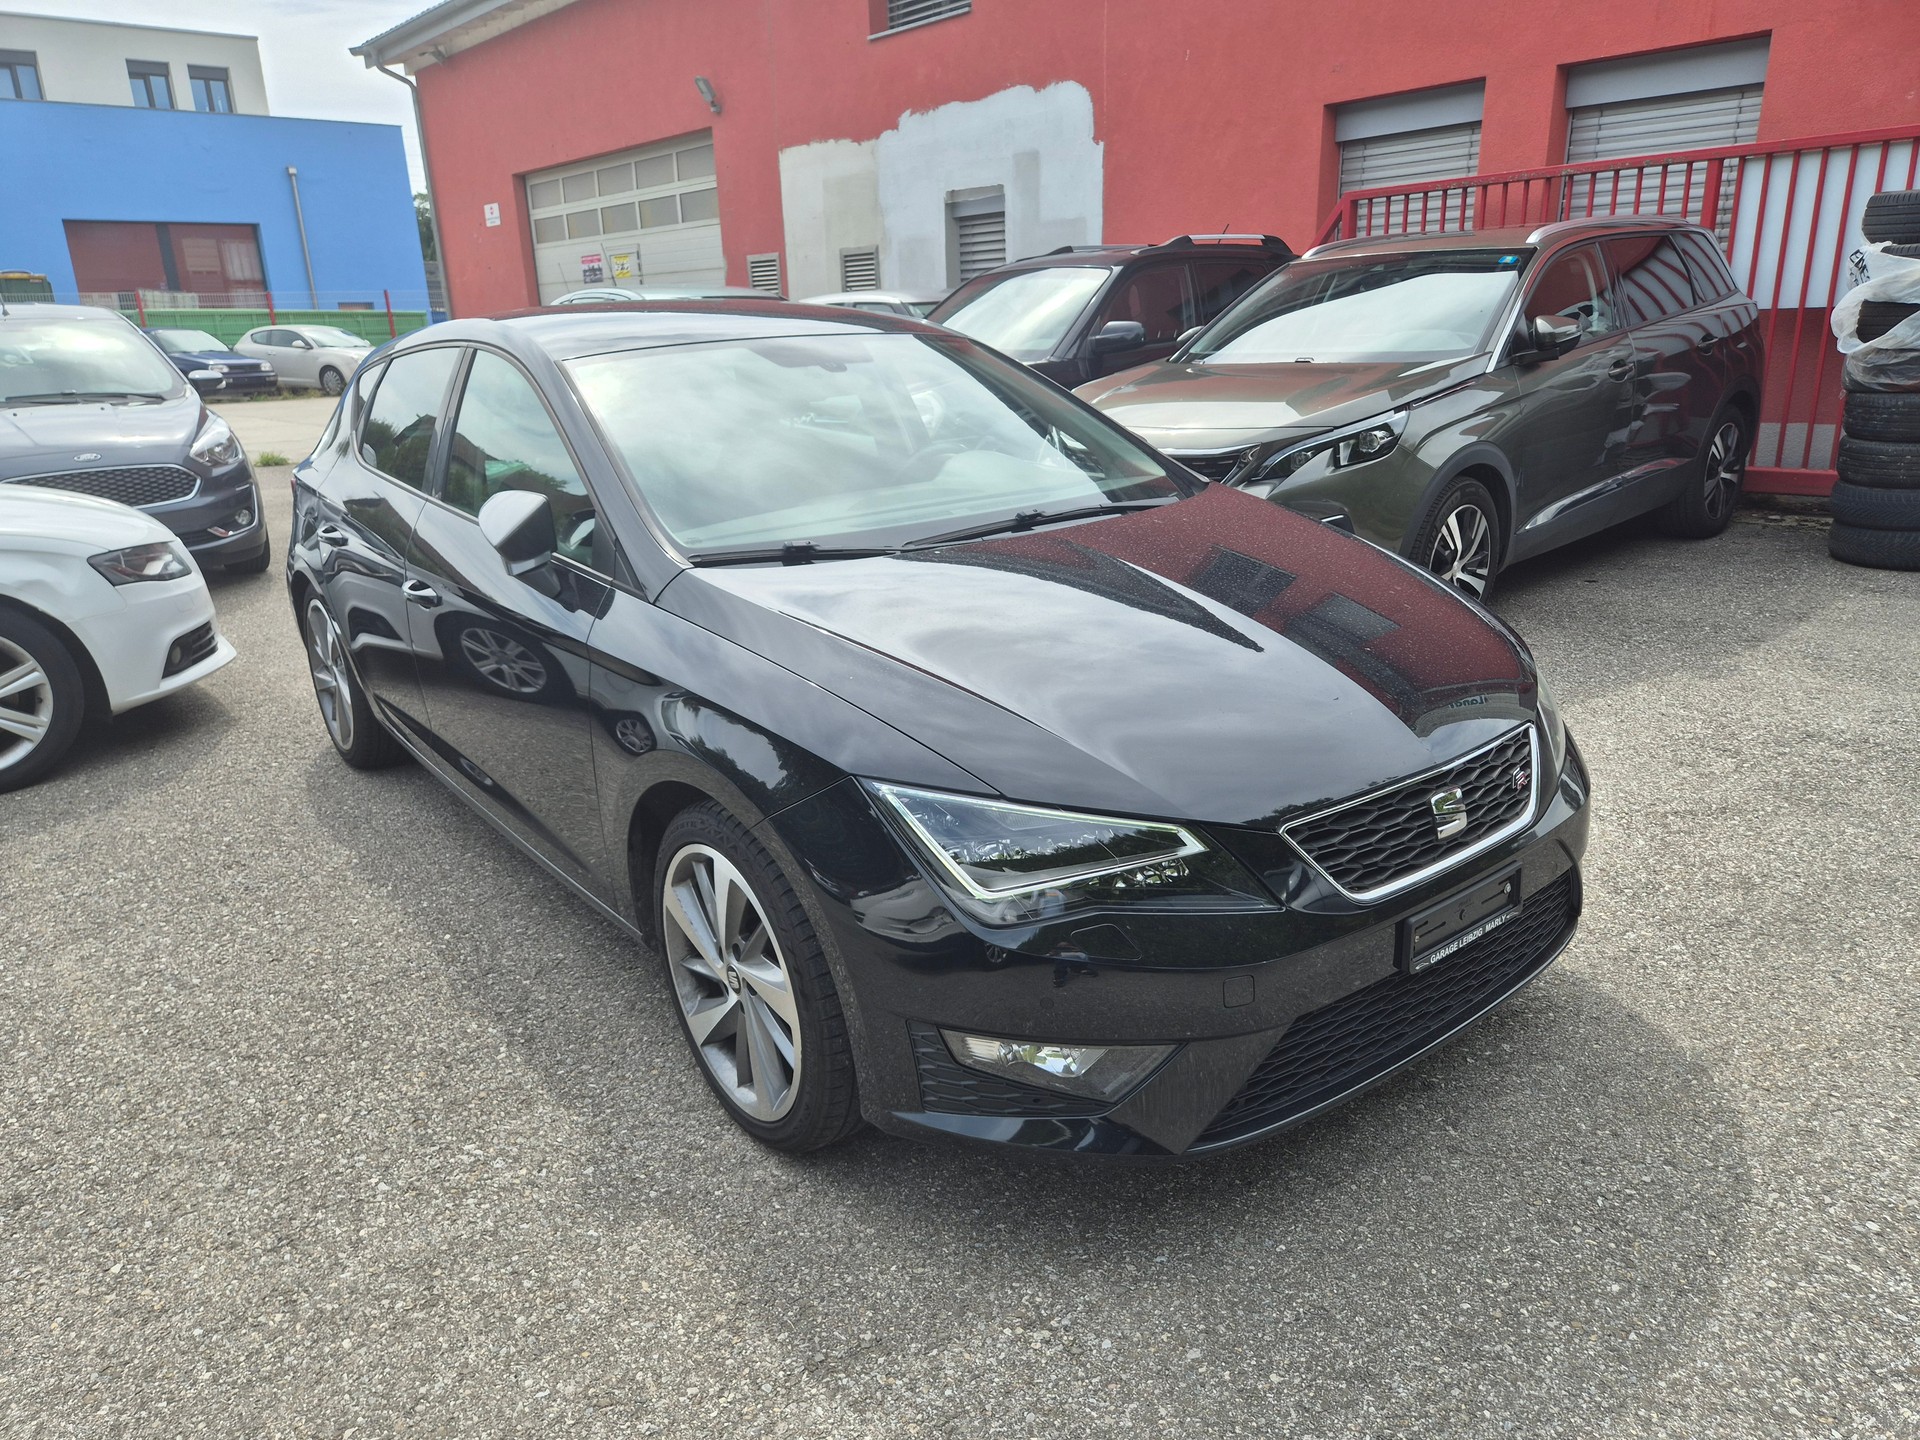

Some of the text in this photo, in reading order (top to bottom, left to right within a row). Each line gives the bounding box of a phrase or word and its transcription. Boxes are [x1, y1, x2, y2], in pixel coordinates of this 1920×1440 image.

[1430, 914, 1507, 964] GARAGE LEIBZIG MARLY
